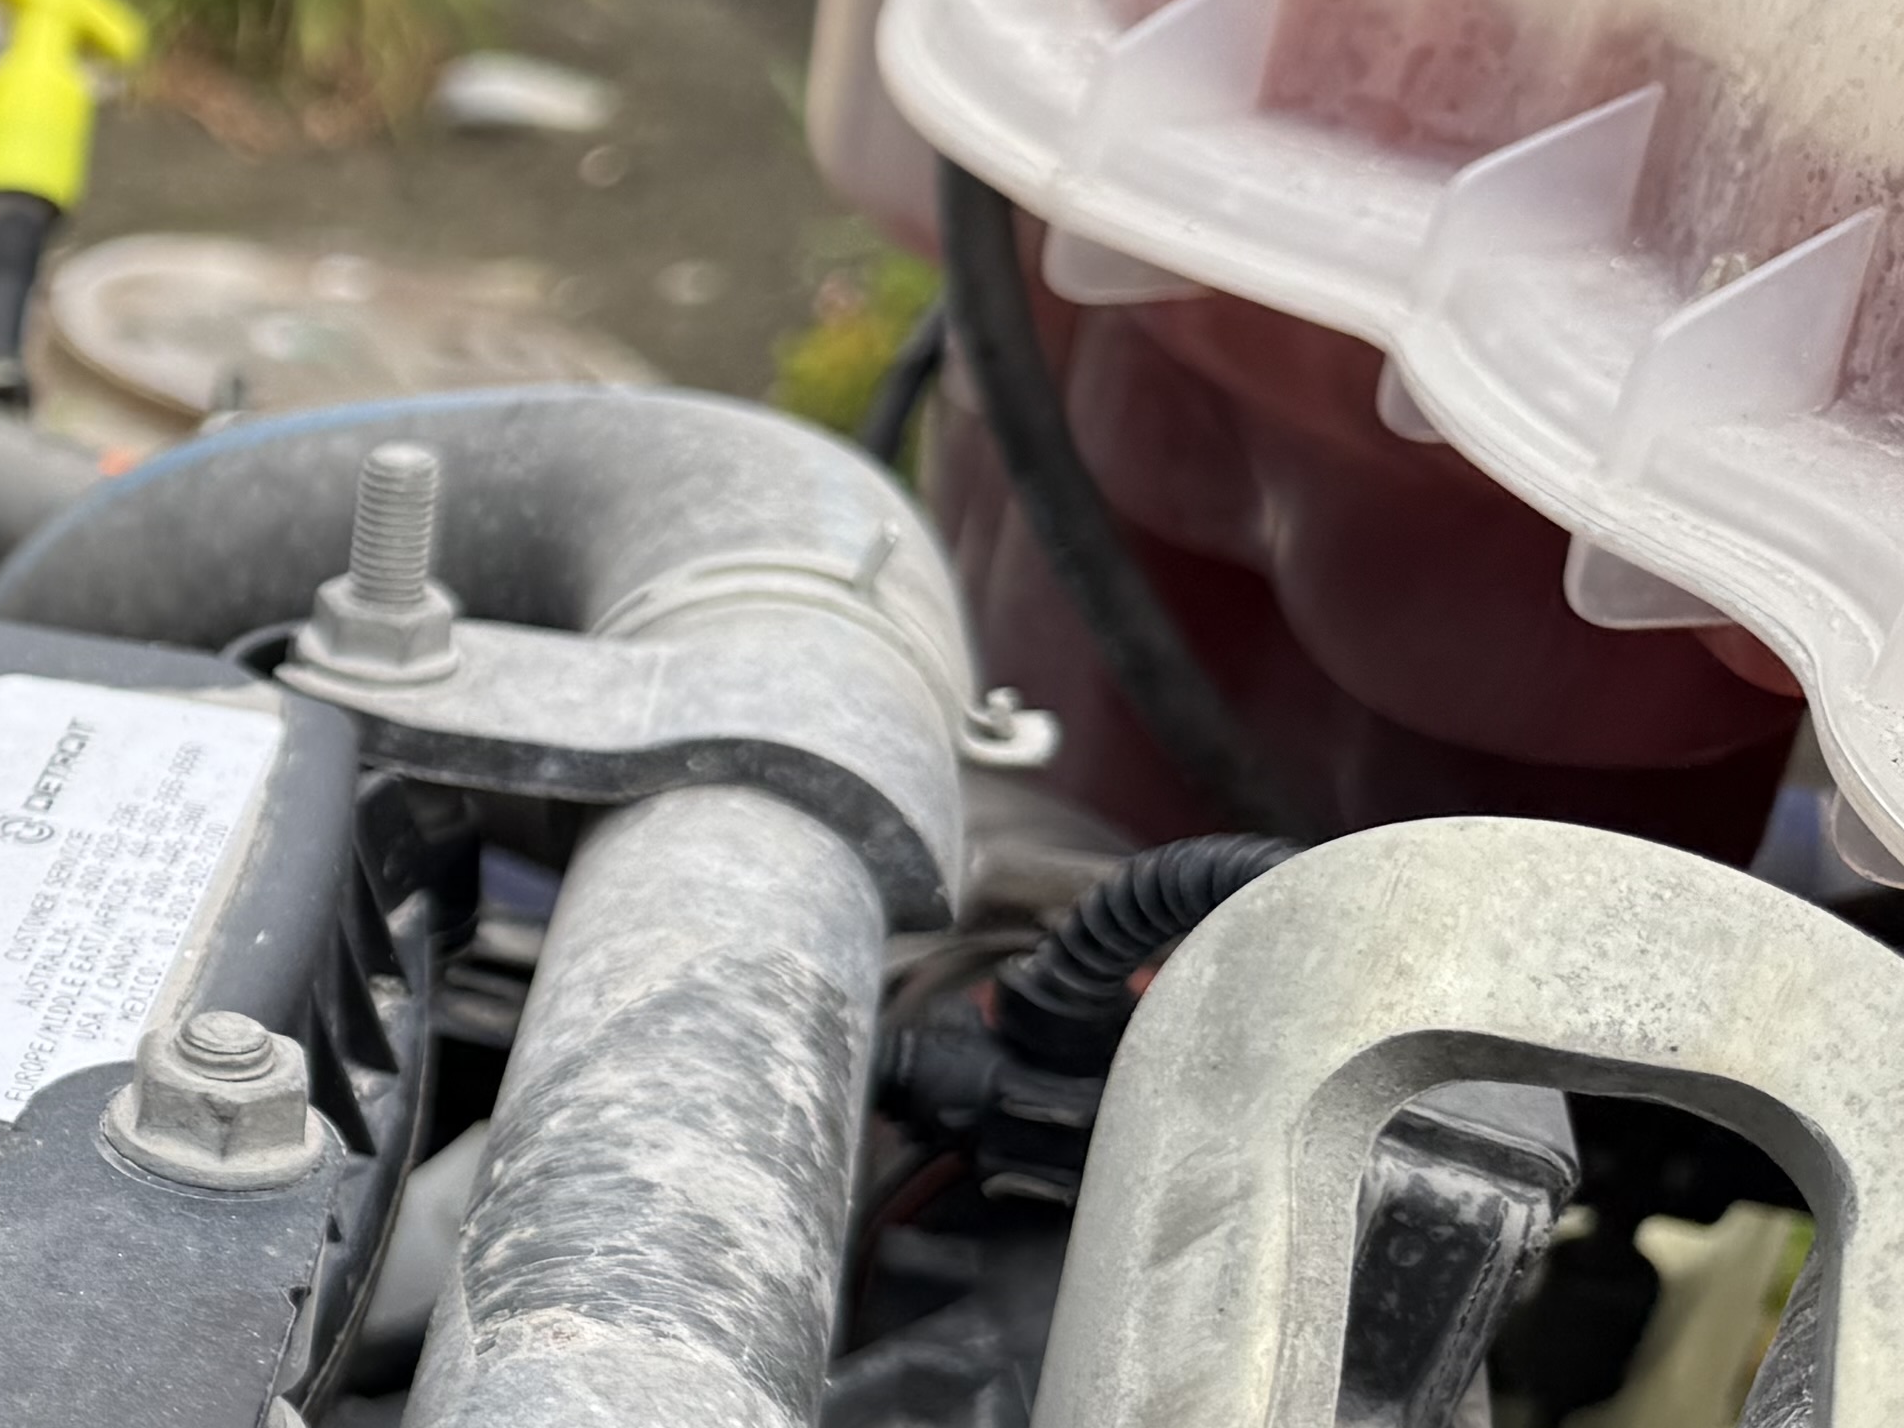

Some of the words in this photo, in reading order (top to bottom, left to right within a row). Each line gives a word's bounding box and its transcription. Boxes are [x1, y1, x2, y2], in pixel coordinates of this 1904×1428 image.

[24, 718, 96, 812] DETROIT
[5, 890, 59, 962] CUSTOMER
[43, 829, 91, 887] SERVICE
[17, 920, 77, 1009] AUSTRALIA:
[7, 977, 85, 1103] EUROPE/MIDDLE
[74, 1011, 105, 1040] USA
